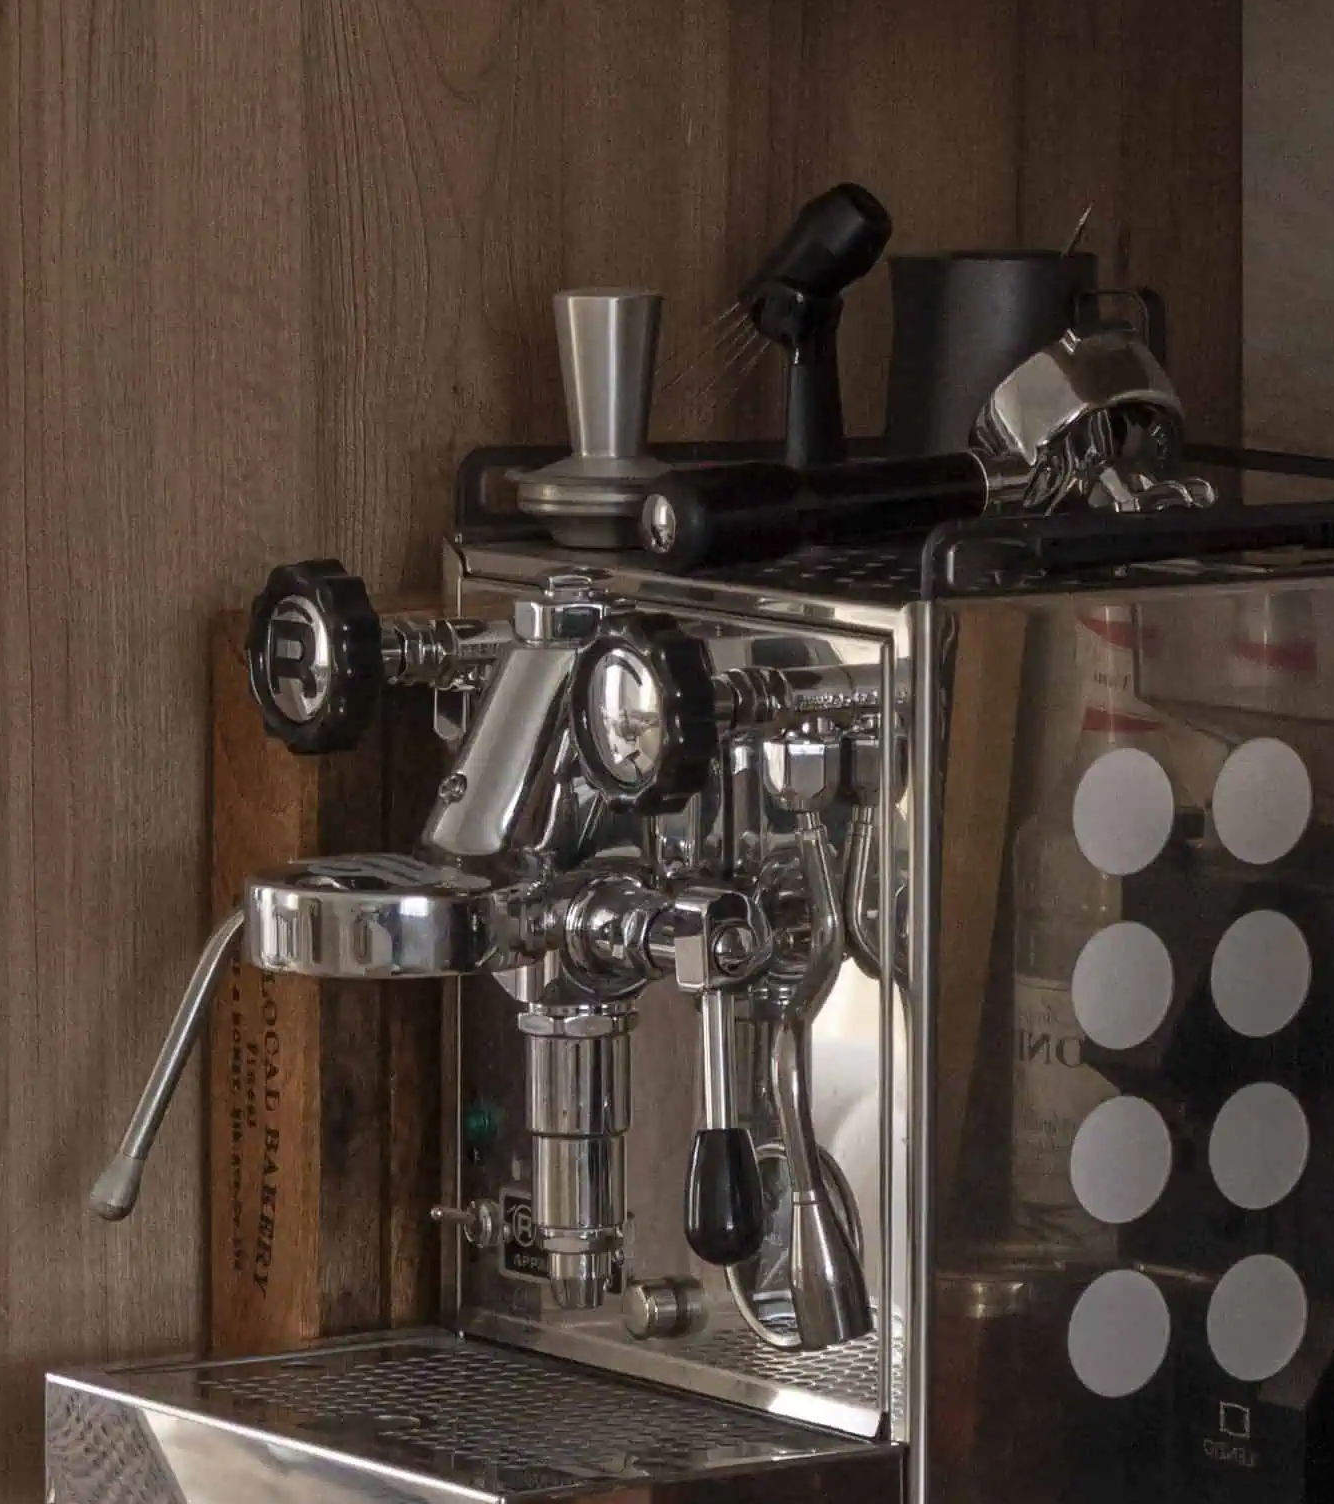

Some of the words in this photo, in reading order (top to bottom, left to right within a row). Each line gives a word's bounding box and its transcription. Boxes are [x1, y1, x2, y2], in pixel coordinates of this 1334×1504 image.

[271, 619, 317, 698] R
[261, 973, 281, 1112] LOCAL
[253, 1124, 281, 1300] BAKERY
